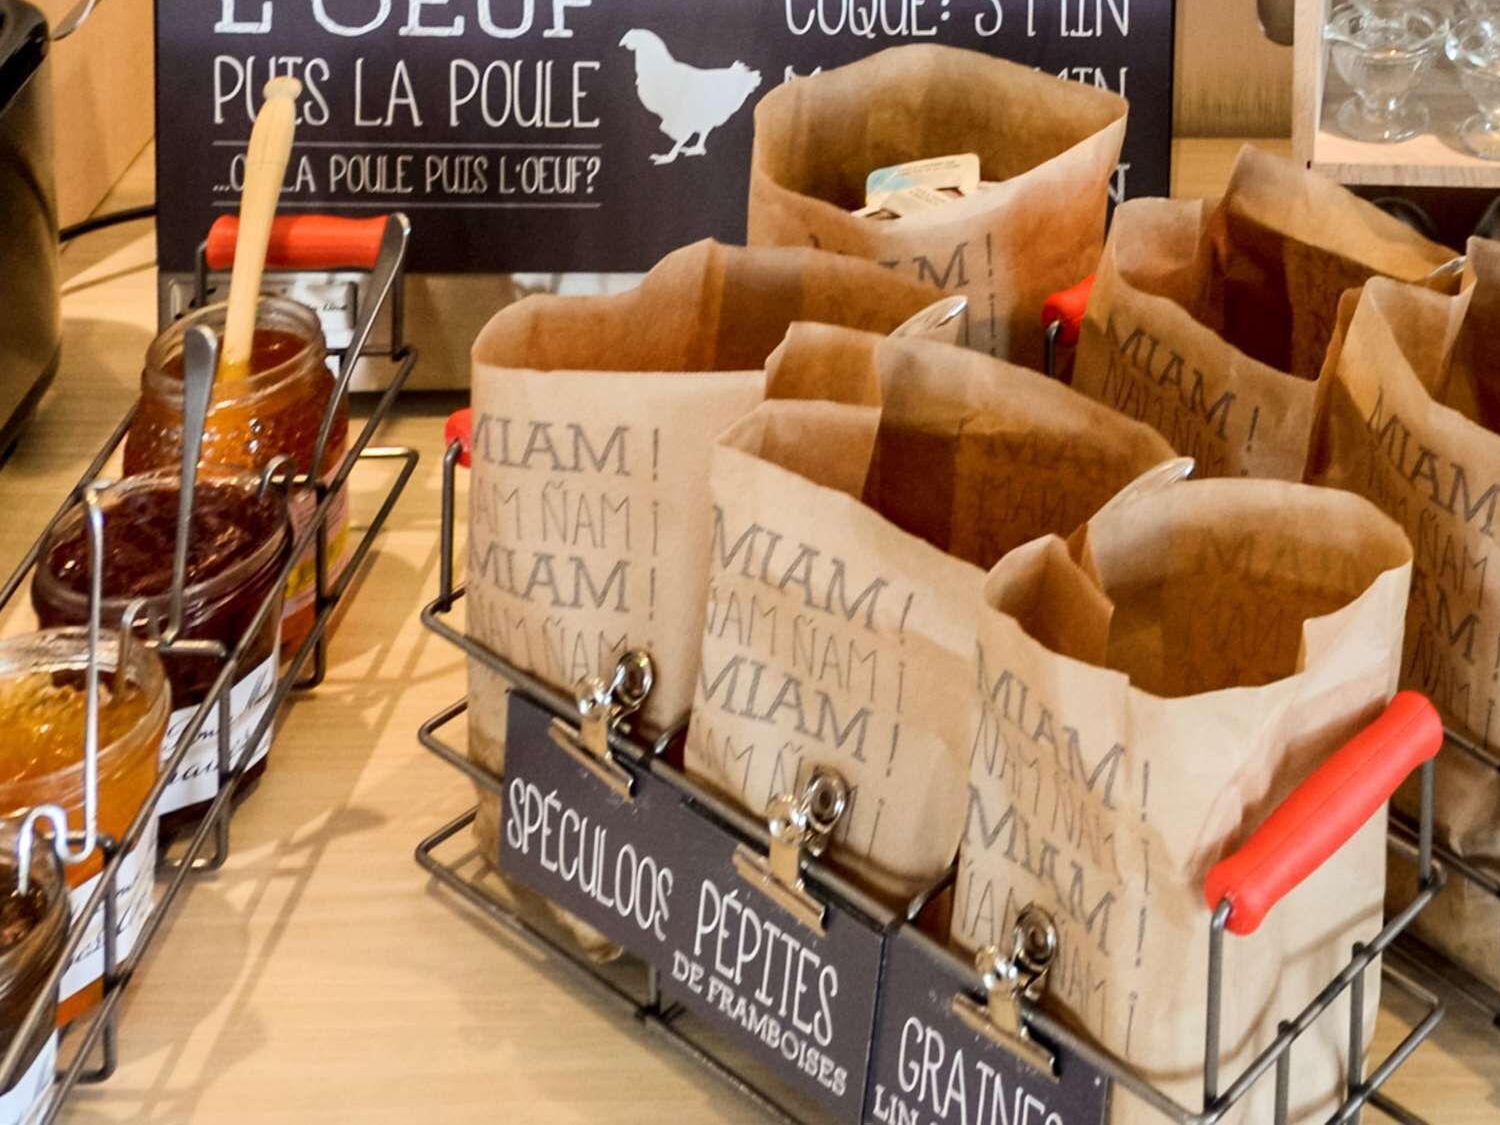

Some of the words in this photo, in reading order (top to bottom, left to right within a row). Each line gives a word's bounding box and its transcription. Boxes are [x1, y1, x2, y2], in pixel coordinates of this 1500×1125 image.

[355, 57, 423, 127] LA
[449, 59, 601, 128] POULE
[329, 154, 414, 194] POULE
[425, 154, 490, 195] PUIS
[499, 155, 601, 195] L'OEUF?
[712, 504, 889, 635] MIAM
[507, 777, 674, 942] SPÉCULOOS
[693, 878, 839, 1047] PÉPITES
[672, 950, 704, 994] DE
[706, 975, 849, 1097] FRAMBOISES
[898, 1016, 1064, 1125] GRAIN
